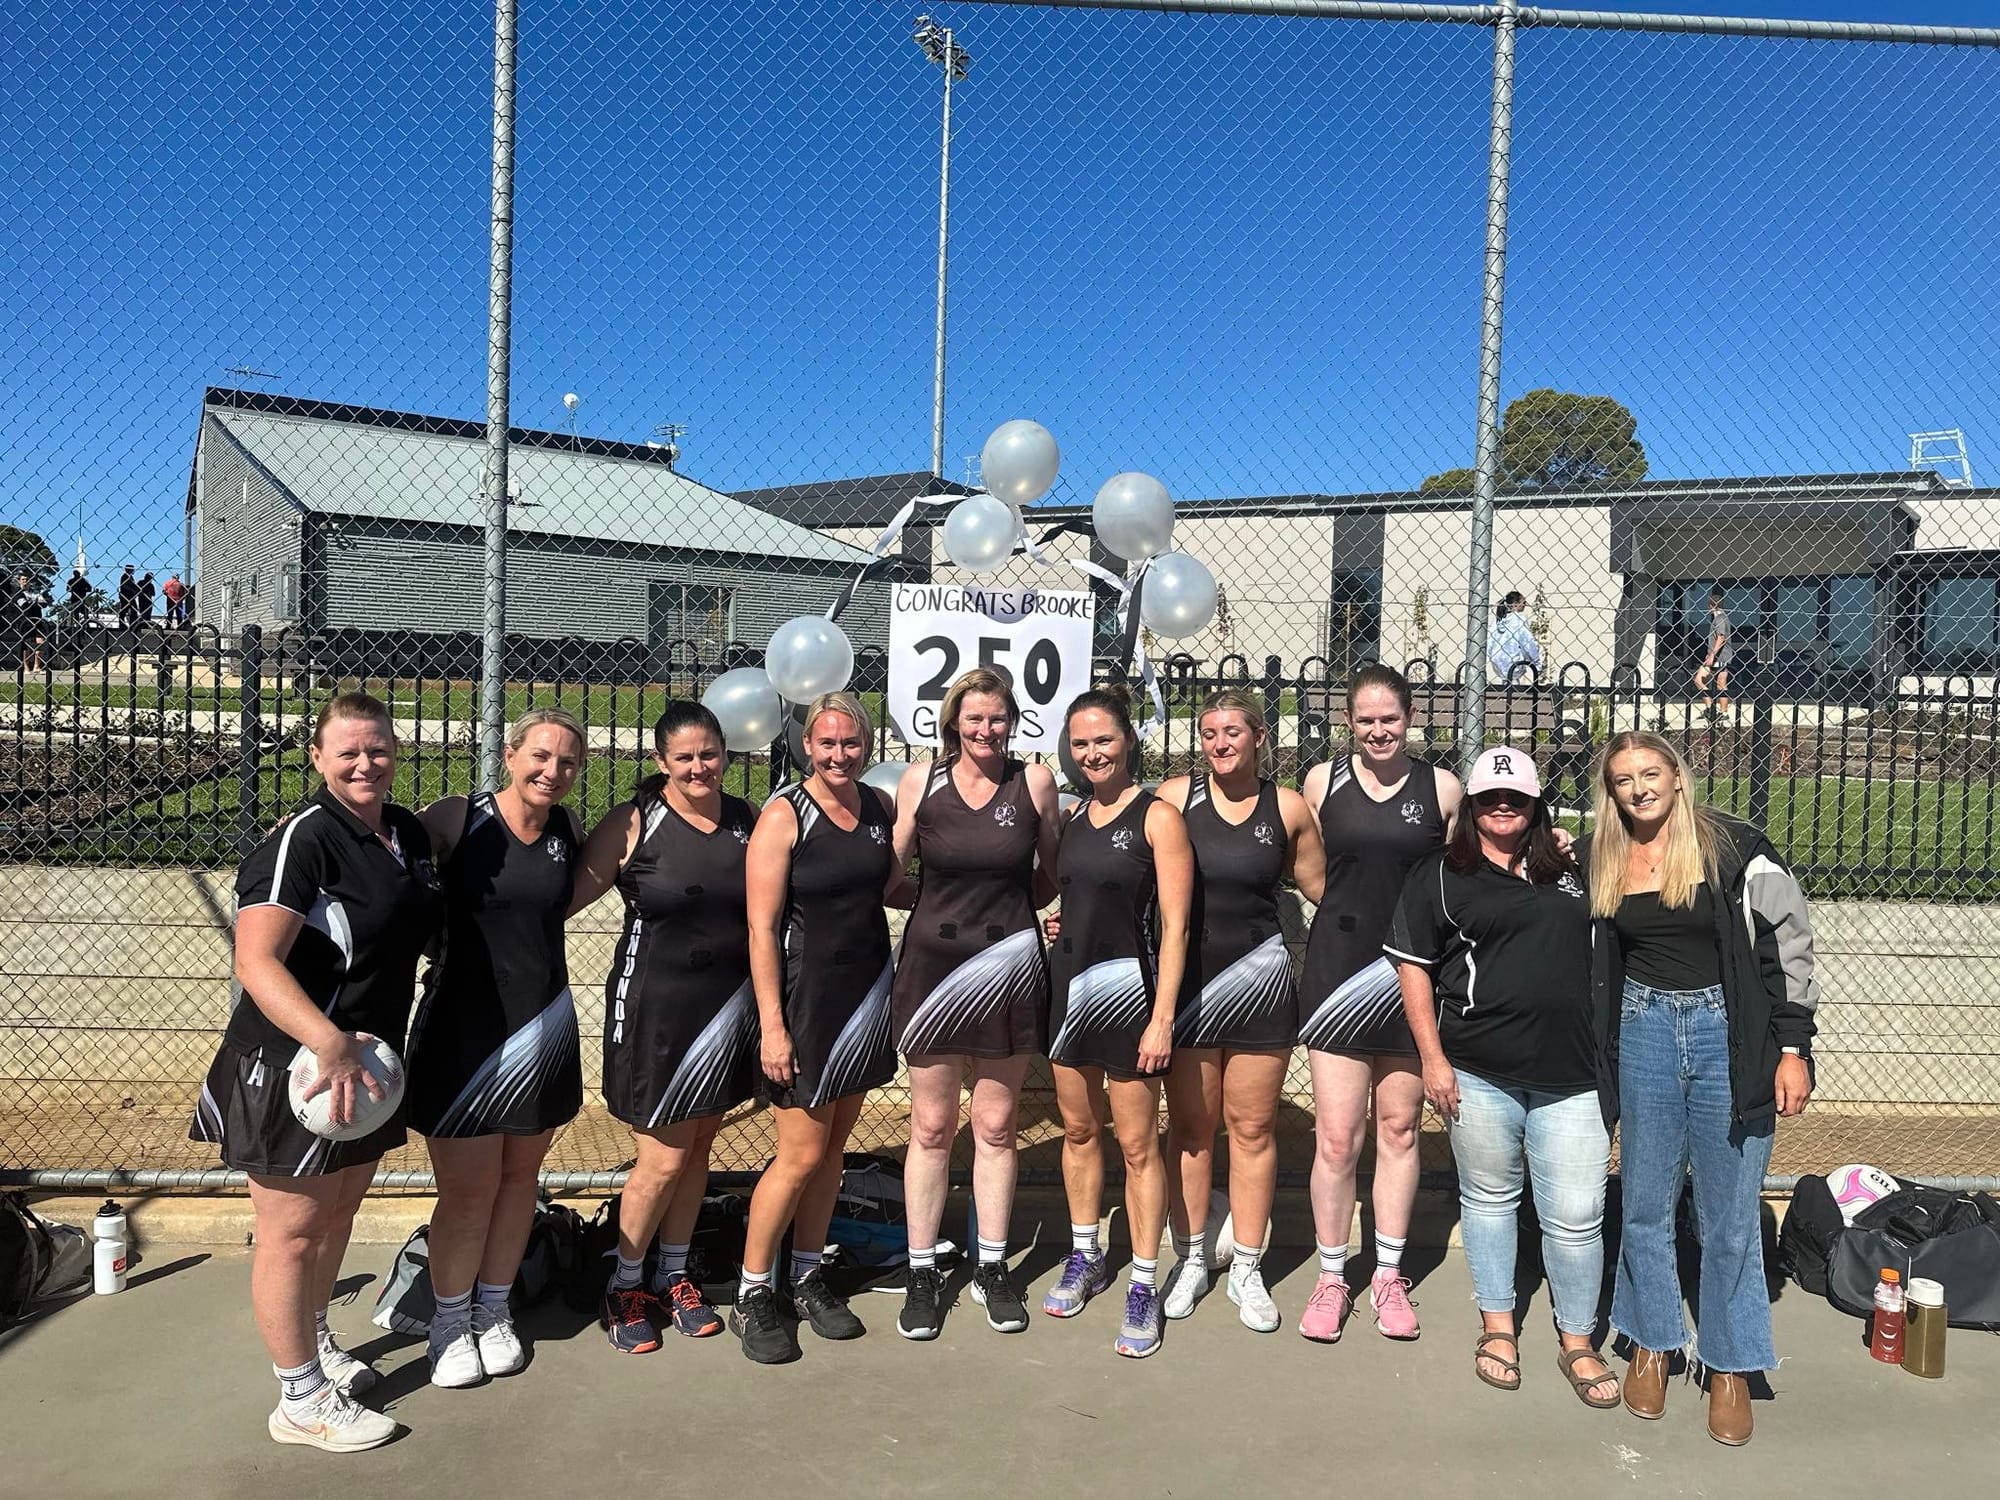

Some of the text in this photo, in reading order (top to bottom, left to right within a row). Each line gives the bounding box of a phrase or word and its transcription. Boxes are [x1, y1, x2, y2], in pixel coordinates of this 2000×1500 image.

[896, 585, 1094, 619] CONGRATS BROOKE
[912, 635, 1062, 706] 250
